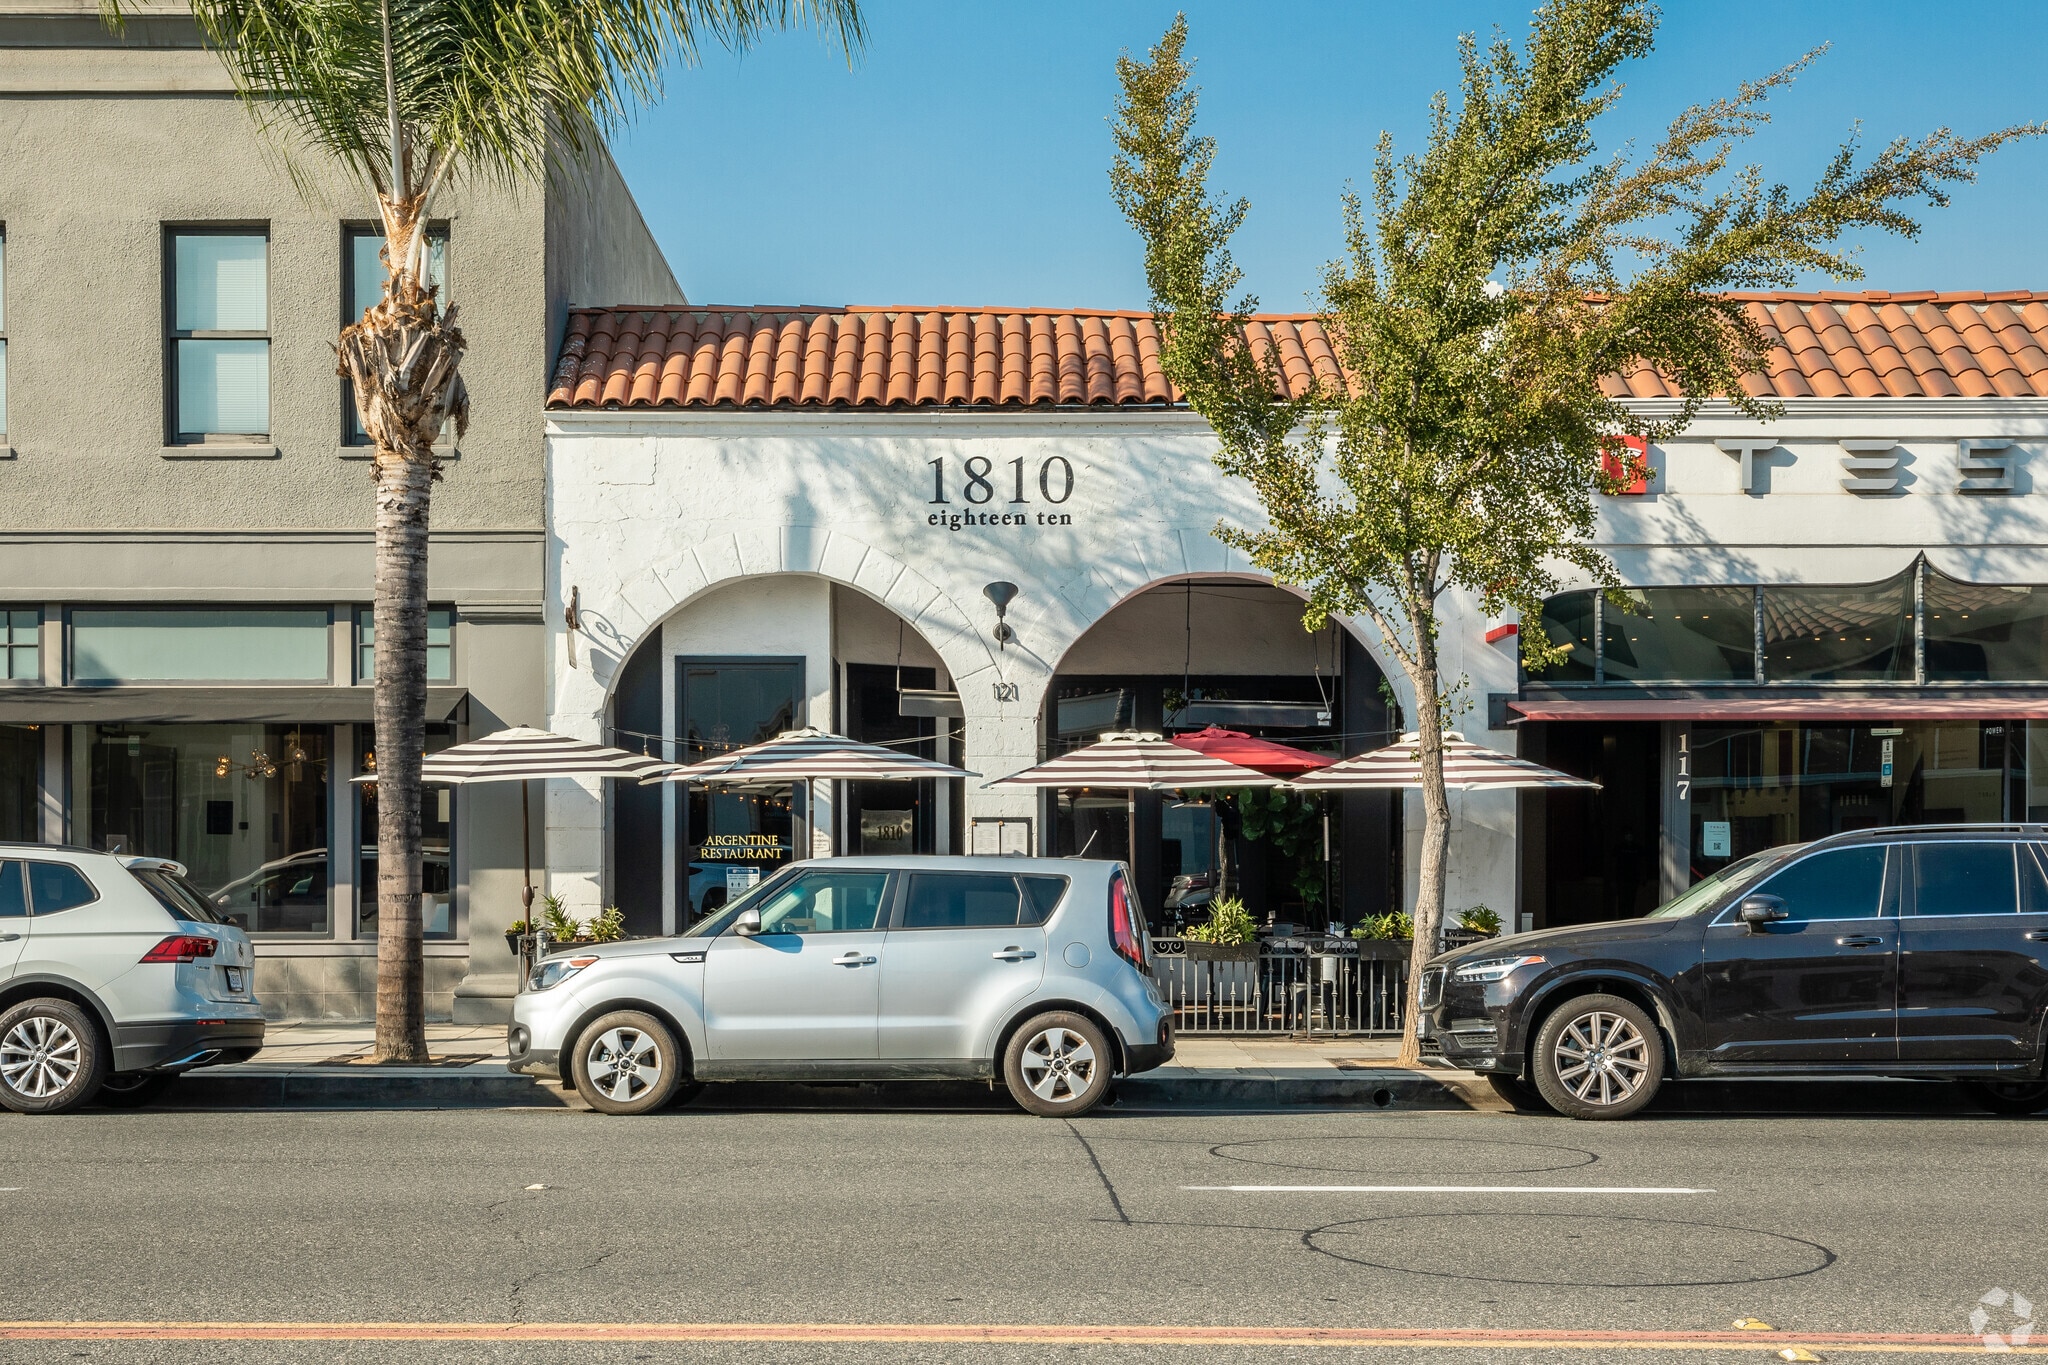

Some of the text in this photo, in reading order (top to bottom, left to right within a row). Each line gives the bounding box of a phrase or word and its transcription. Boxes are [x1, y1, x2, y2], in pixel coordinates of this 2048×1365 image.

[927, 455, 1075, 505] 1810
[927, 507, 1073, 532] eighteen ten
[992, 682, 1017, 700] 121
[705, 834, 778, 846] ARGENTINE
[877, 825, 903, 841] 1810
[701, 848, 783, 859] RESTAURANT
